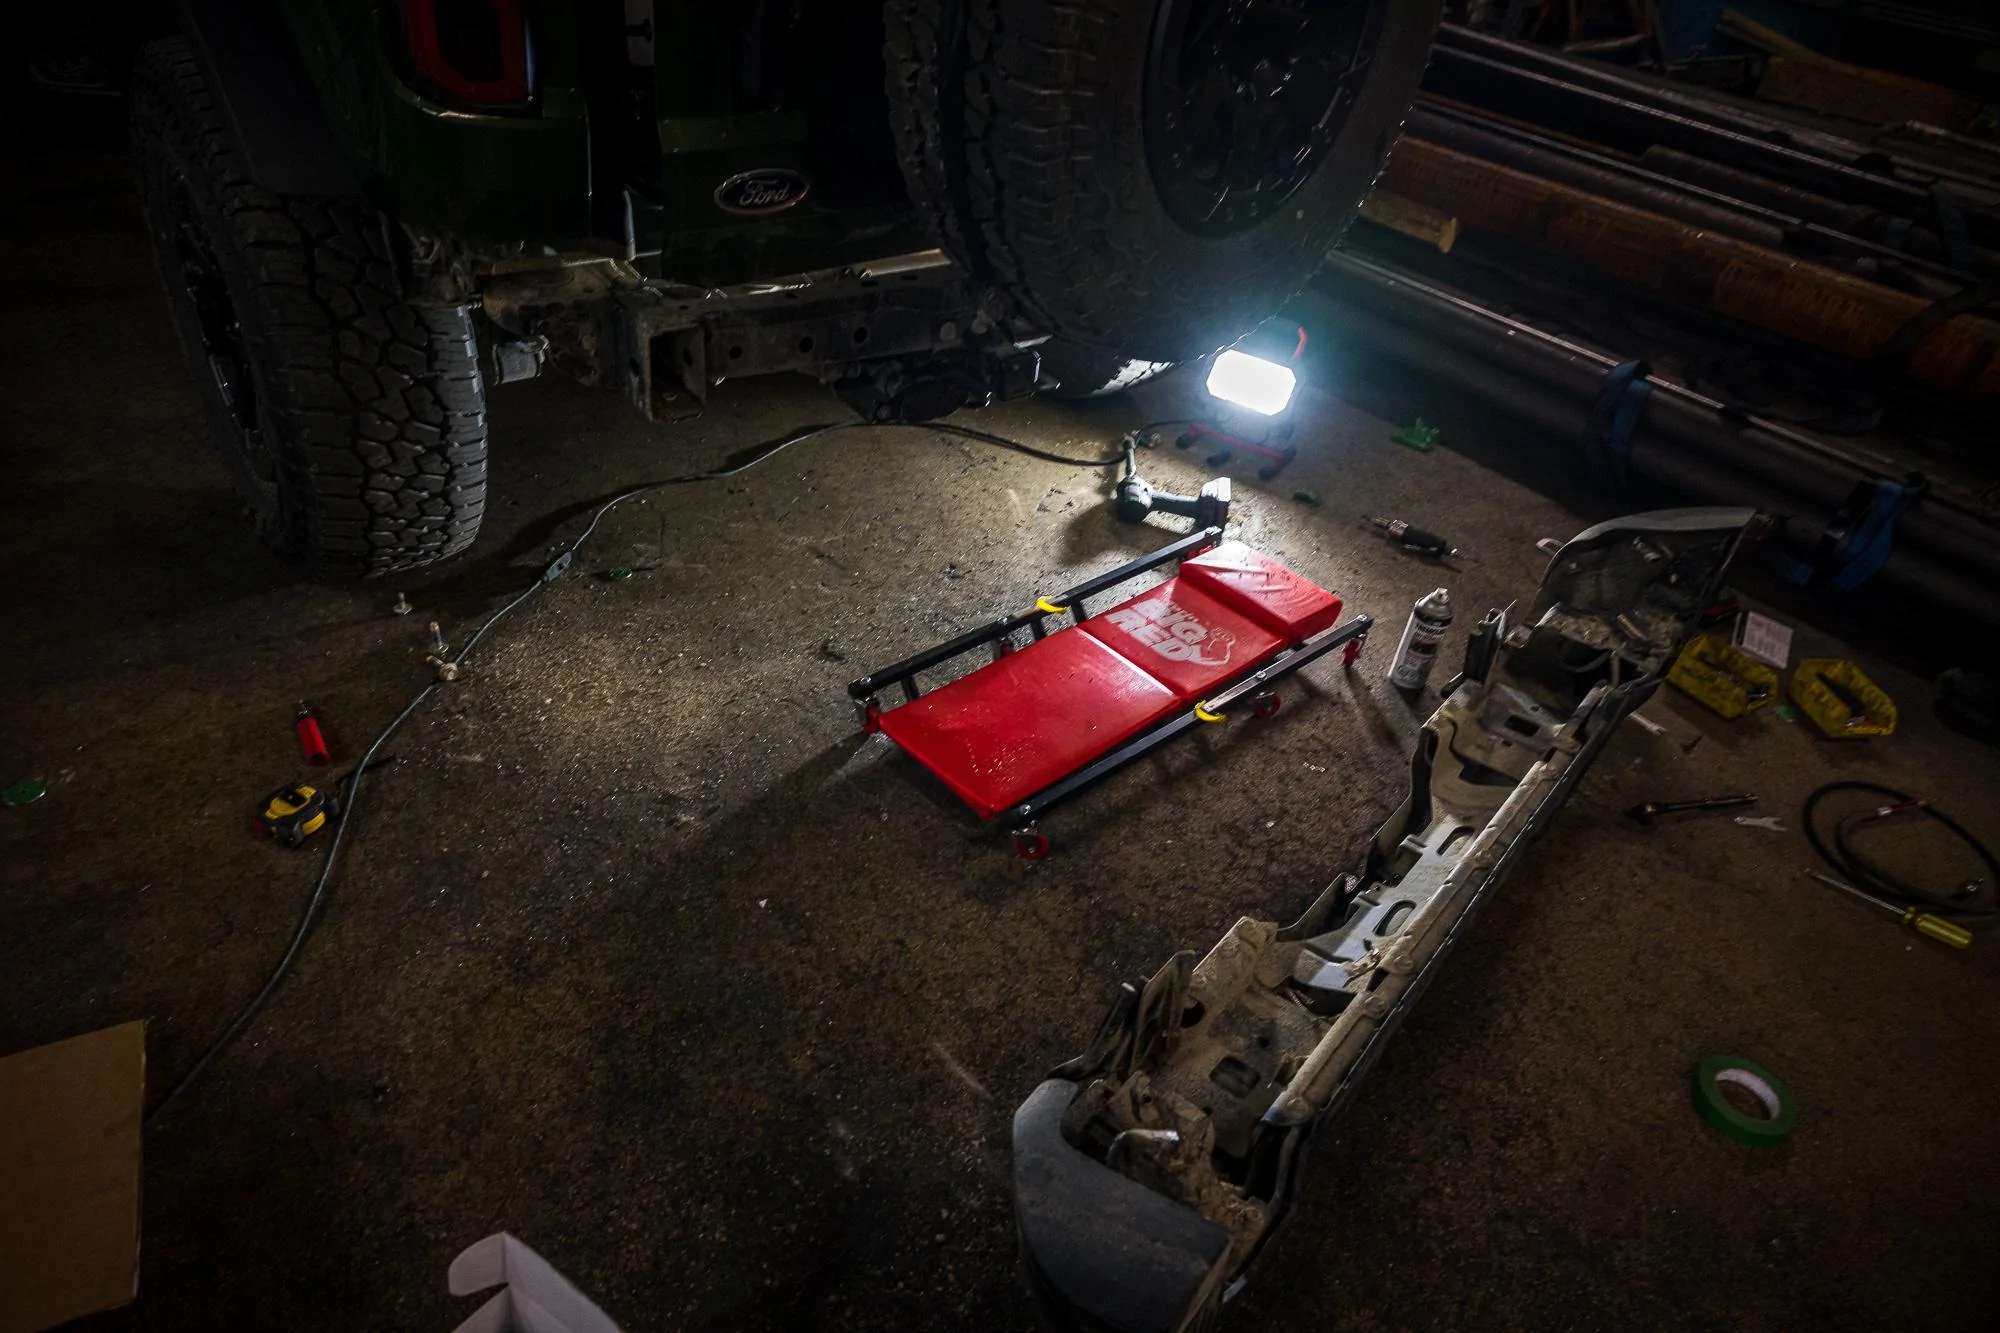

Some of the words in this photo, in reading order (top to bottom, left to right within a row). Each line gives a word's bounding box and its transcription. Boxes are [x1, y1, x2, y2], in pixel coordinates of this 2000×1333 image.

[739, 180, 790, 206] Ford
[1104, 608, 1194, 661] RED
[1131, 598, 1209, 646] BIG
